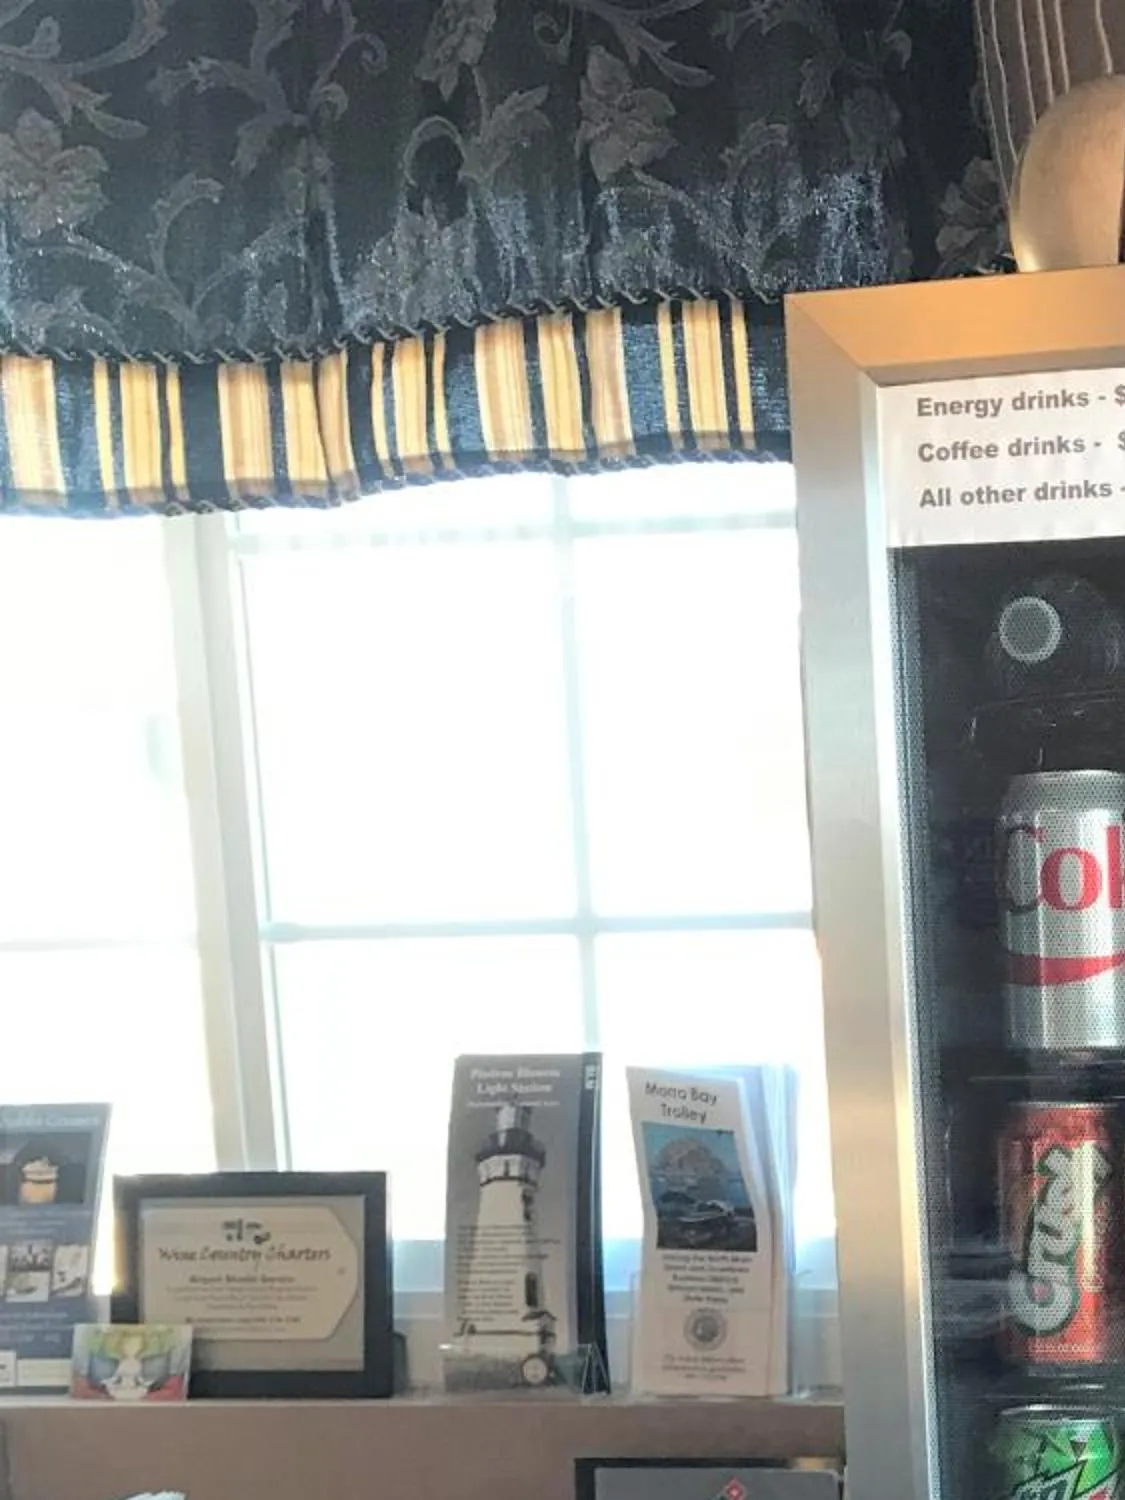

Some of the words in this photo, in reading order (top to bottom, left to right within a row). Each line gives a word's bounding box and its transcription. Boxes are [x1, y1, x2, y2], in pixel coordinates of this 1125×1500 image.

[916, 396, 1003, 418] Energy
[1012, 389, 1090, 411] drinks
[918, 441, 999, 463] Coffee
[1008, 435, 1086, 457] drinks
[919, 488, 951, 508] All
[960, 485, 1026, 506] other
[1034, 480, 1112, 501] drinks
[691, 1087, 717, 1106] Bay
[660, 1103, 707, 1124] Trolley
